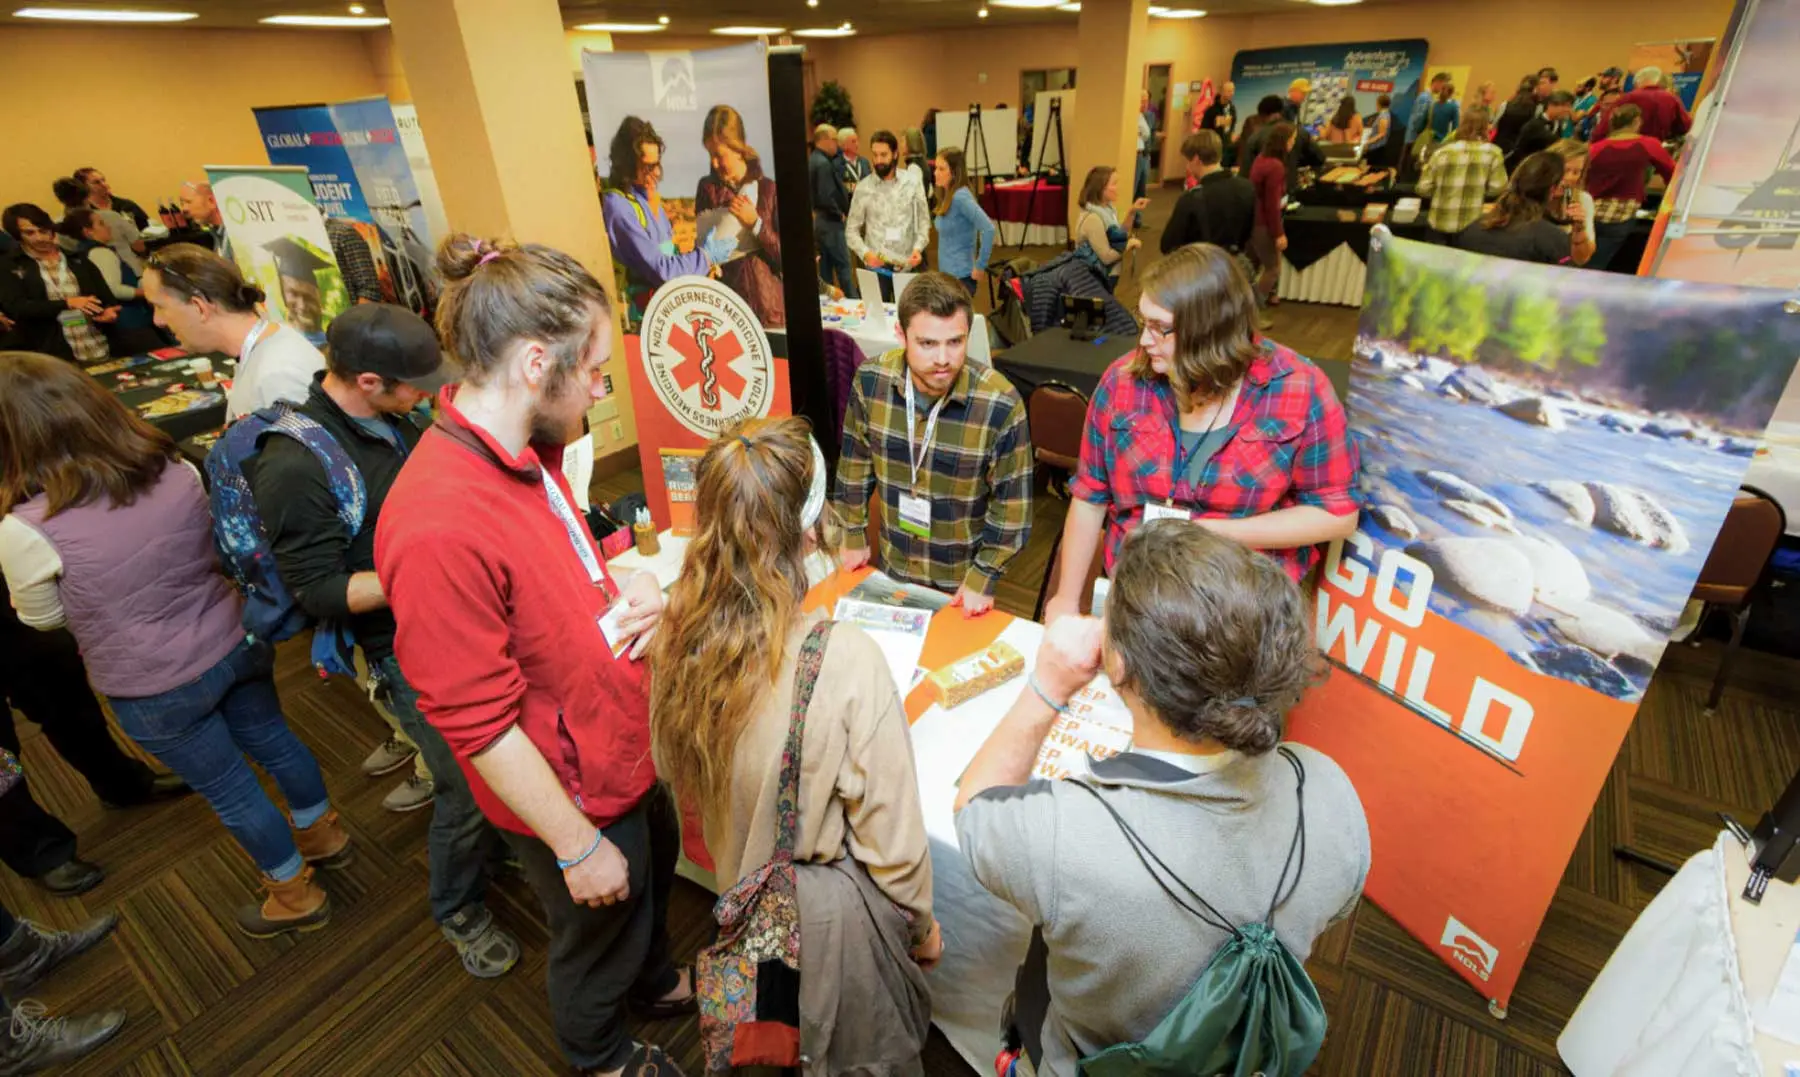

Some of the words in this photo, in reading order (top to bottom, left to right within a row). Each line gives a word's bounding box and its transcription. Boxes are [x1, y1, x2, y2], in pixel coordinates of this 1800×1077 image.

[267, 132, 306, 148] GLOBAL
[246, 200, 275, 222] SIT
[653, 317, 666, 348] NOLS
[660, 291, 722, 319] WILDERNESS
[722, 303, 761, 361] MEDICINE
[655, 361, 691, 418] MEDICINE
[748, 376, 764, 407] NOLS
[1324, 531, 1434, 628] GO
[1315, 588, 1535, 762] WILD
